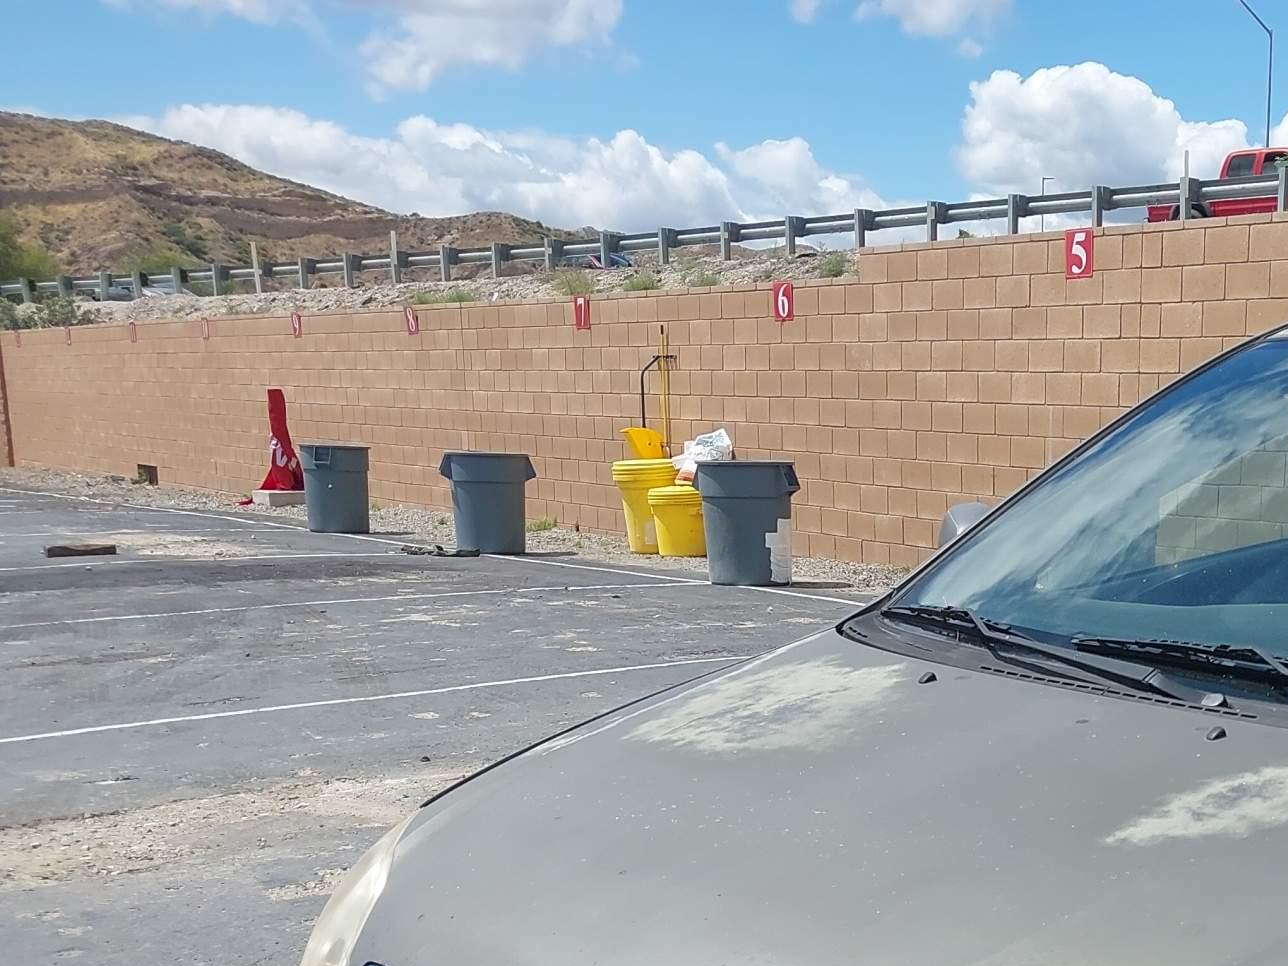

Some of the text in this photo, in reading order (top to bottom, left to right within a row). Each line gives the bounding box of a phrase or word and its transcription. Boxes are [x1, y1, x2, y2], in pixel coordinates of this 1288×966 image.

[1071, 232, 1087, 274] 5
[576, 297, 585, 327] 7
[777, 283, 789, 318] 6
[406, 307, 416, 332] 8
